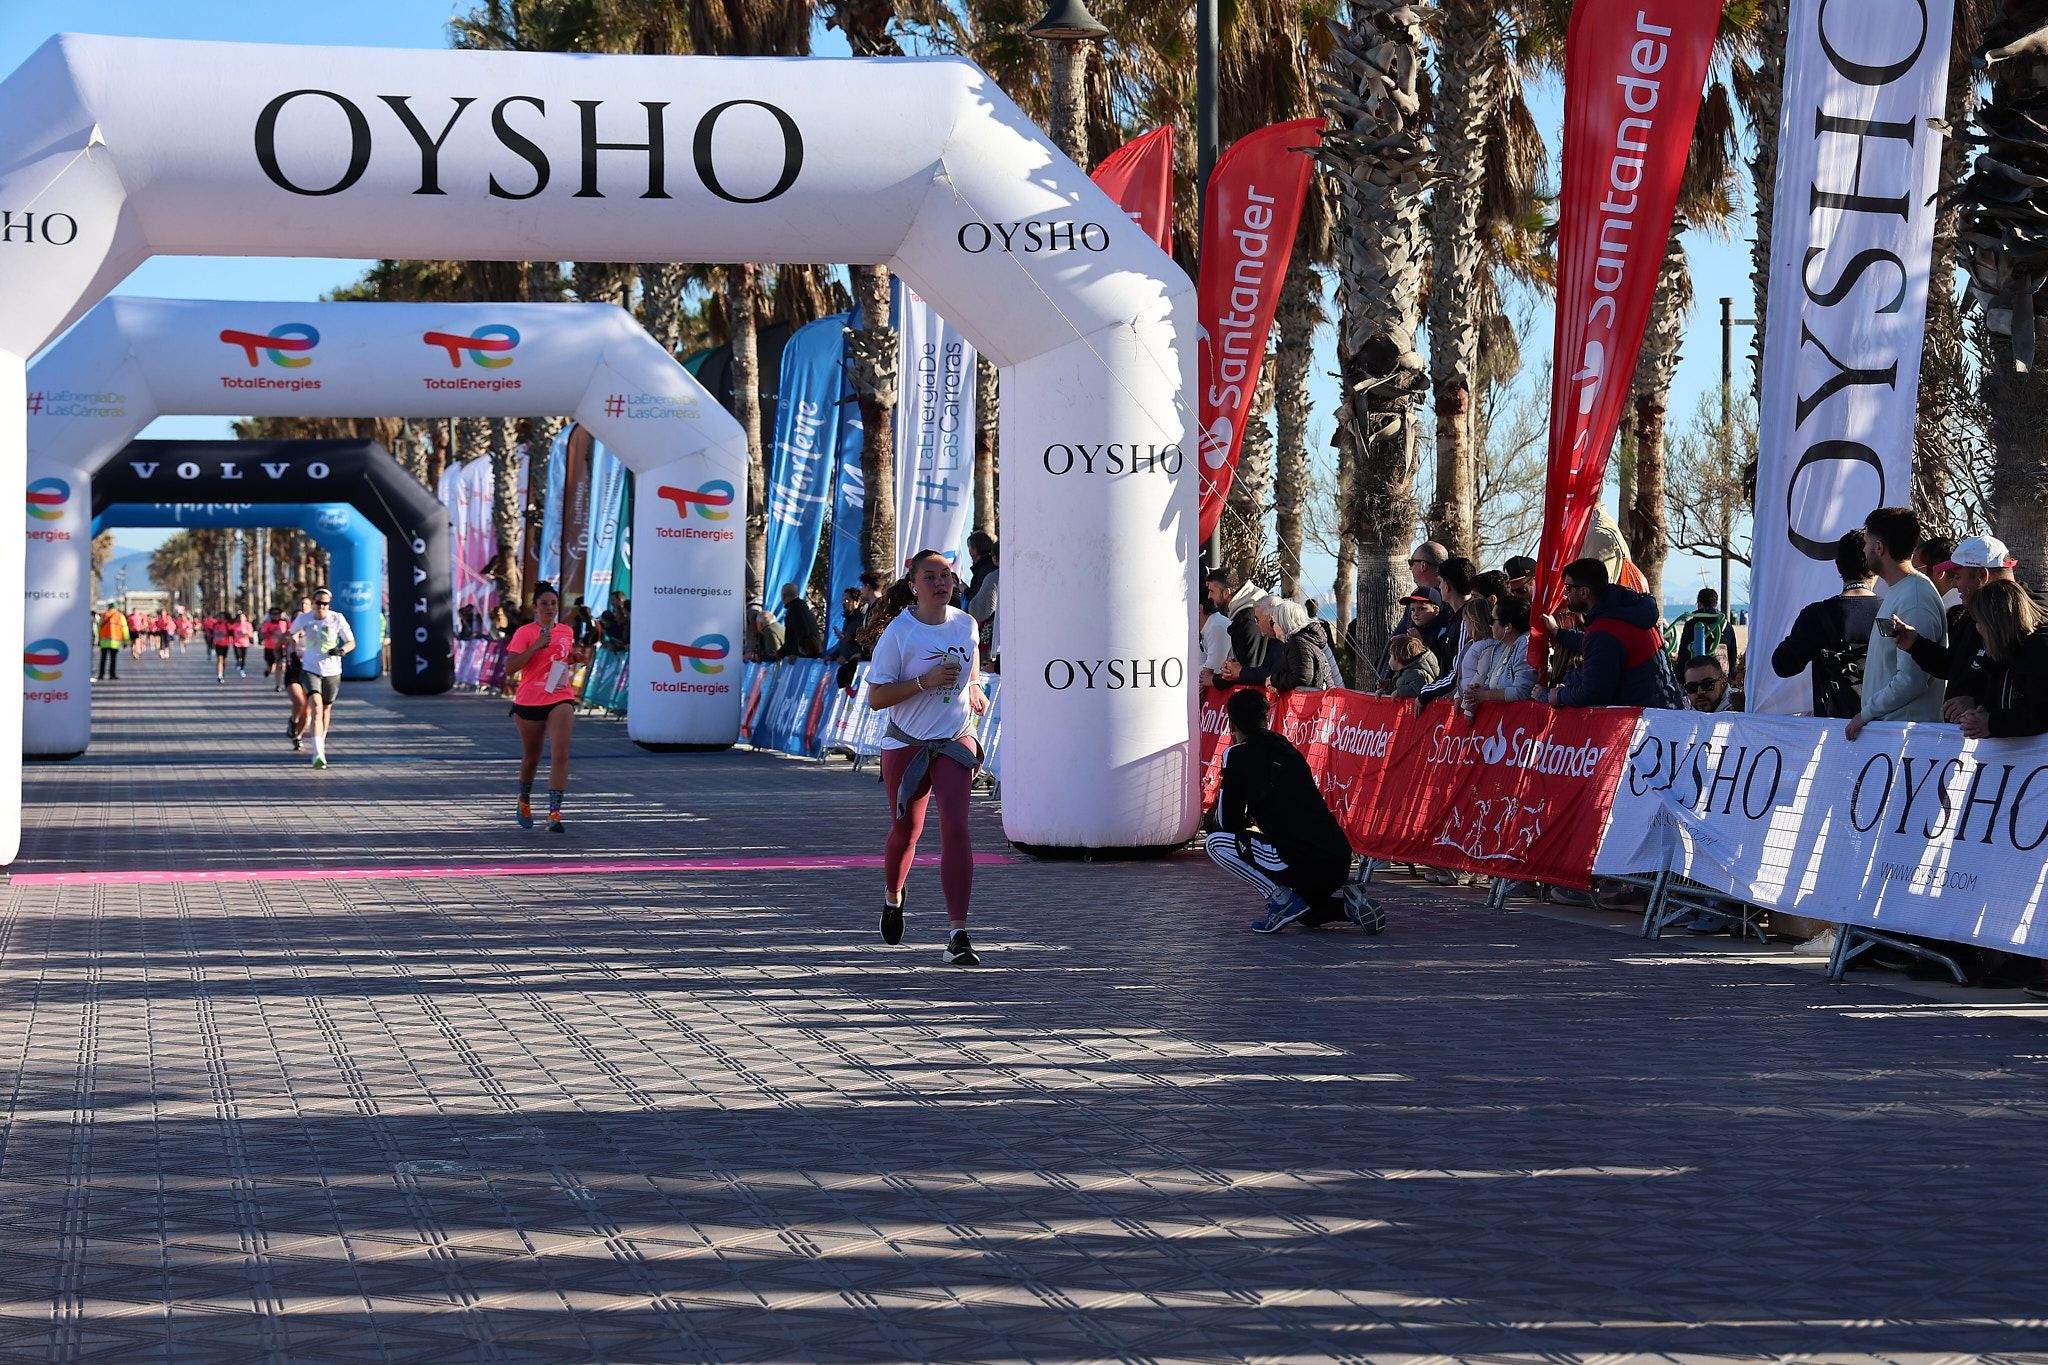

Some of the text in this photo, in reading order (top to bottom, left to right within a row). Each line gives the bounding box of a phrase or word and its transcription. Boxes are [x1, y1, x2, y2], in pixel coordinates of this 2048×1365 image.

[254, 89, 804, 204] OYSHO
[1588, 10, 1673, 330] Santander
[957, 221, 1110, 253] OYSHO
[1208, 184, 1275, 409] Santander
[1787, 0, 1928, 561] OYSHO
[220, 377, 321, 392] TotalEnergies
[423, 377, 522, 392] TotalEnergies
[938, 342, 962, 471] LasCarreras
[129, 461, 331, 480] VOLVO
[1043, 443, 1183, 476] OYSHO
[26, 530, 71, 543] nergies
[655, 527, 735, 542] TotalEnergies
[412, 538, 429, 674] VOLVO
[653, 586, 732, 597] totalenergies.es
[650, 681, 730, 696] TotalEnergies
[1044, 657, 1183, 690] OYSHO
[24, 689, 70, 704] nergies
[1200, 701, 1231, 736] Santa
[1332, 713, 1394, 758] Santander
[1505, 726, 1608, 778] Santander
[1629, 736, 1782, 820] OYSHO
[1850, 752, 2048, 852] OYSHO
[1880, 862, 1978, 891] WWW.OYSHO.COM
